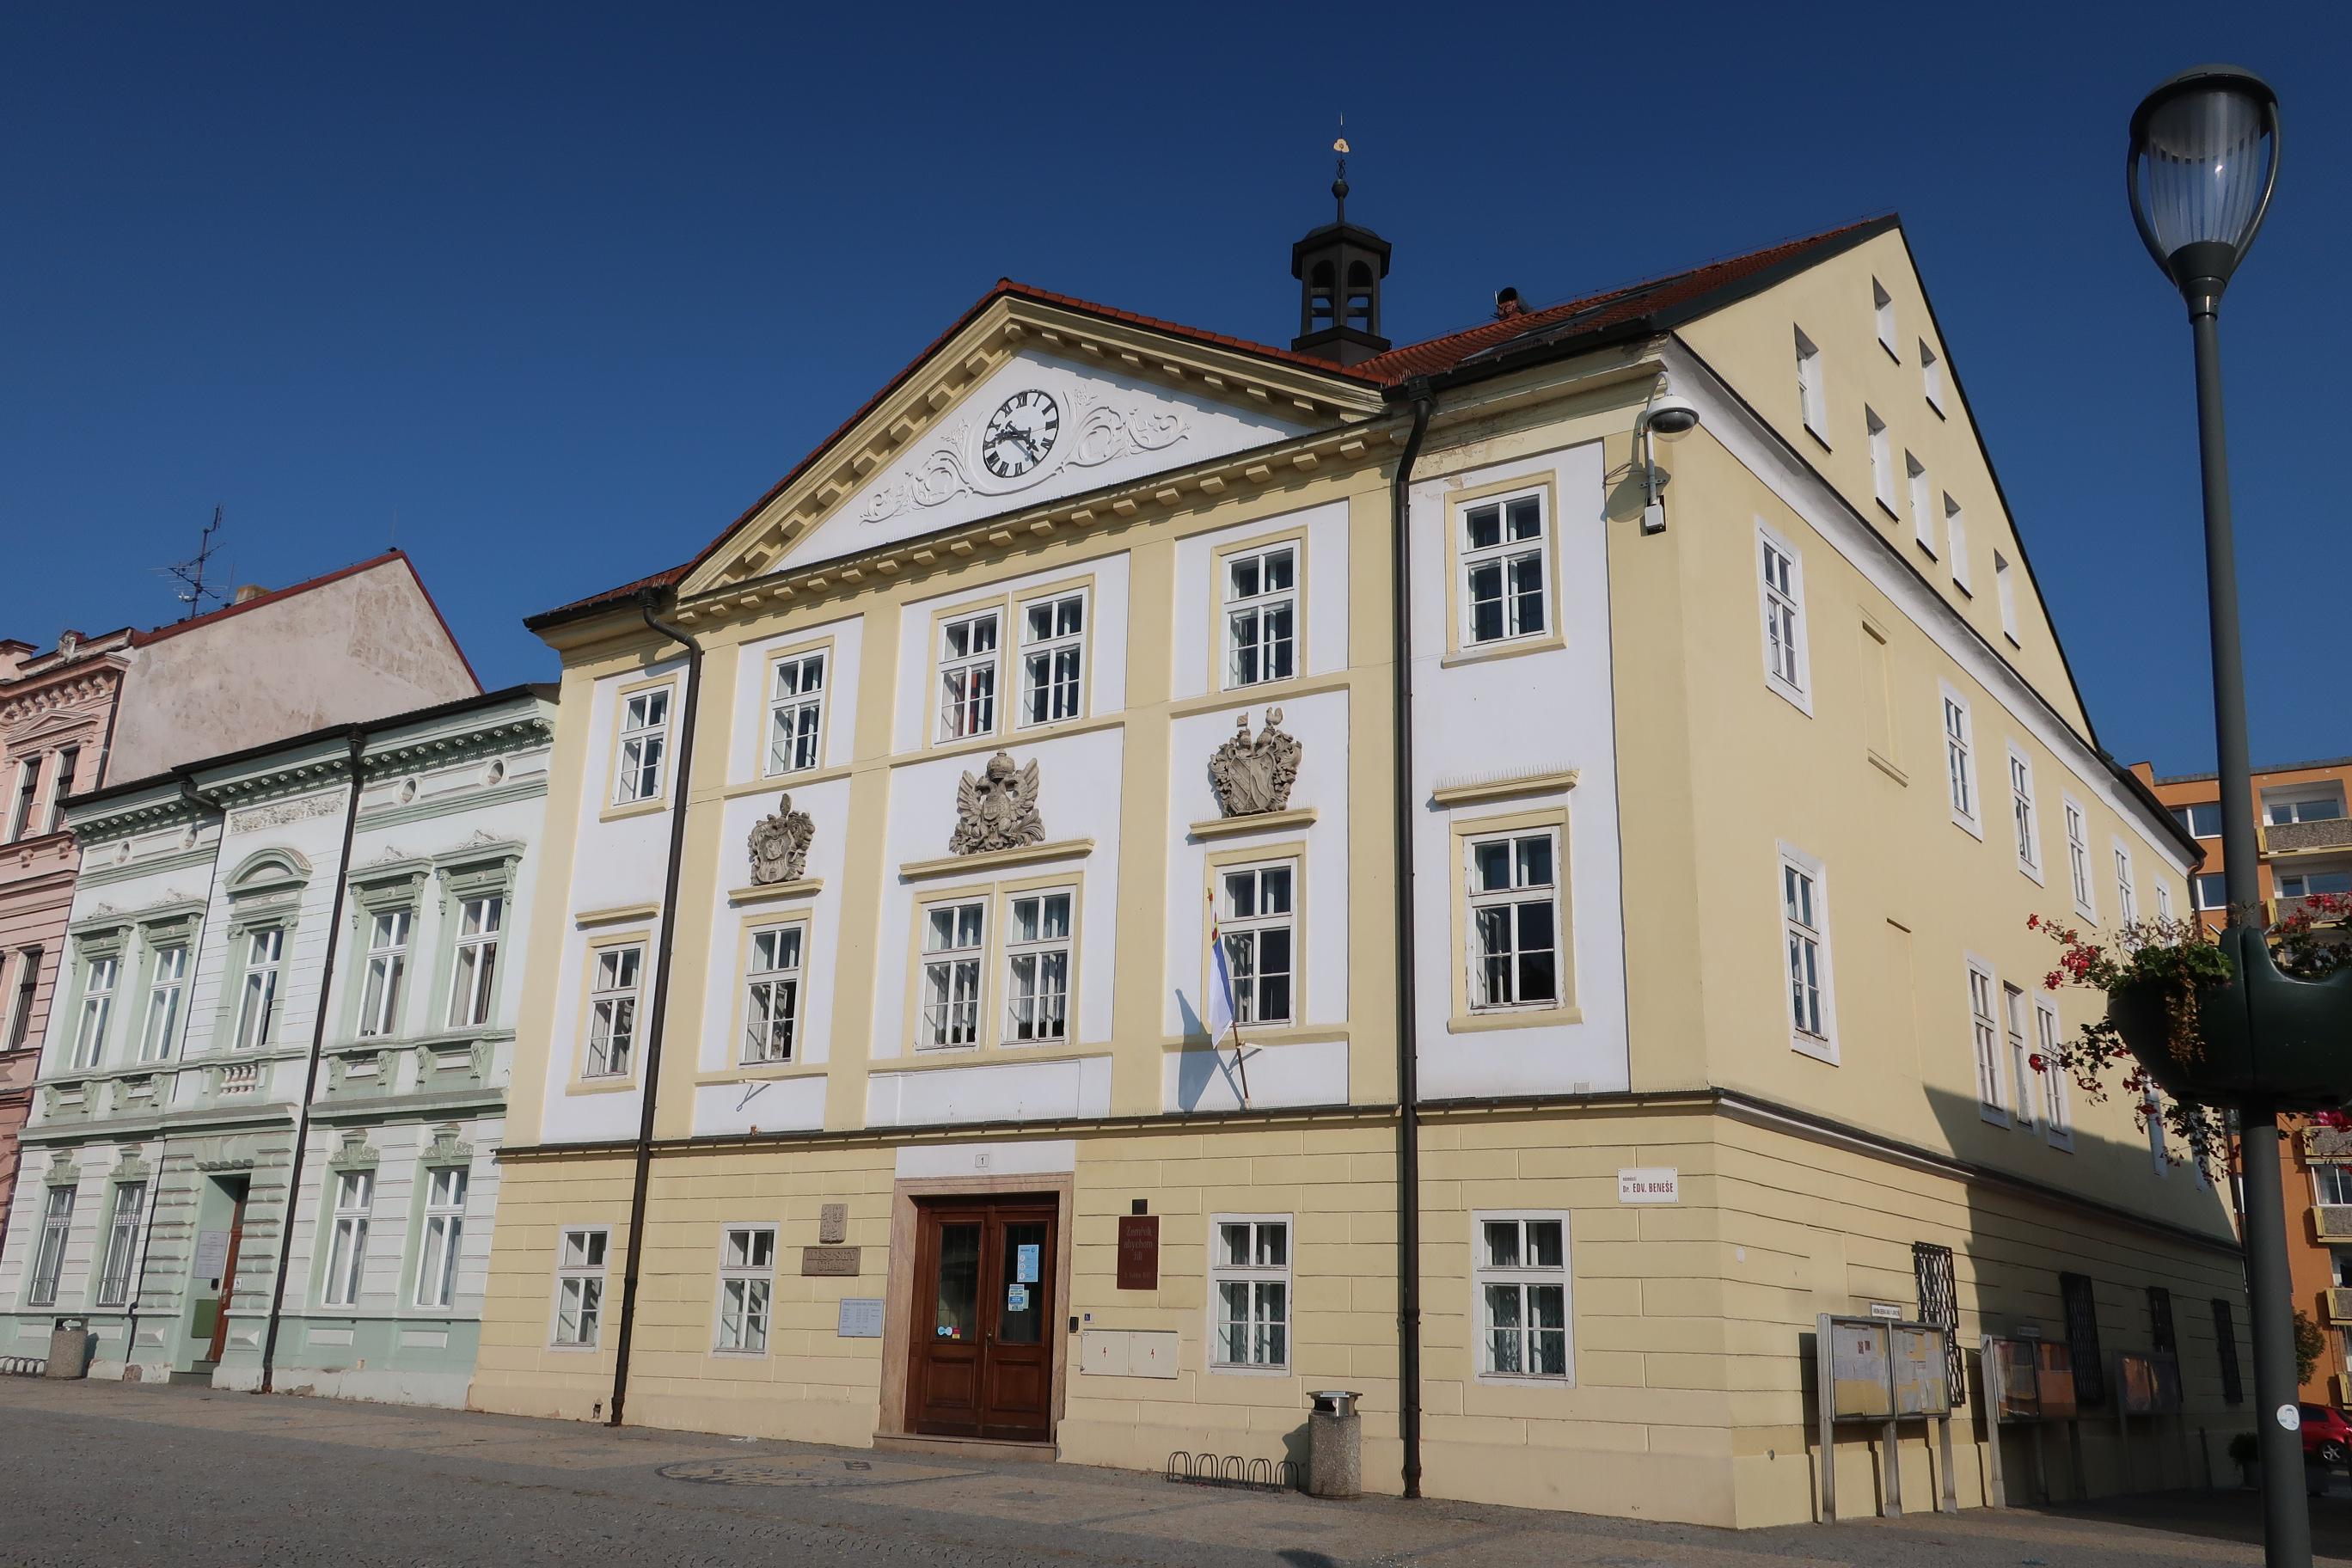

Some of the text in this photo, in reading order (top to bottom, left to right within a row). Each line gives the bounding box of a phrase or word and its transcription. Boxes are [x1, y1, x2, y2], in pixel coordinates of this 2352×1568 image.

[1016, 392, 1028, 409] XII
[1622, 1179, 1674, 1193] Dr. EDV. BENEŠE
